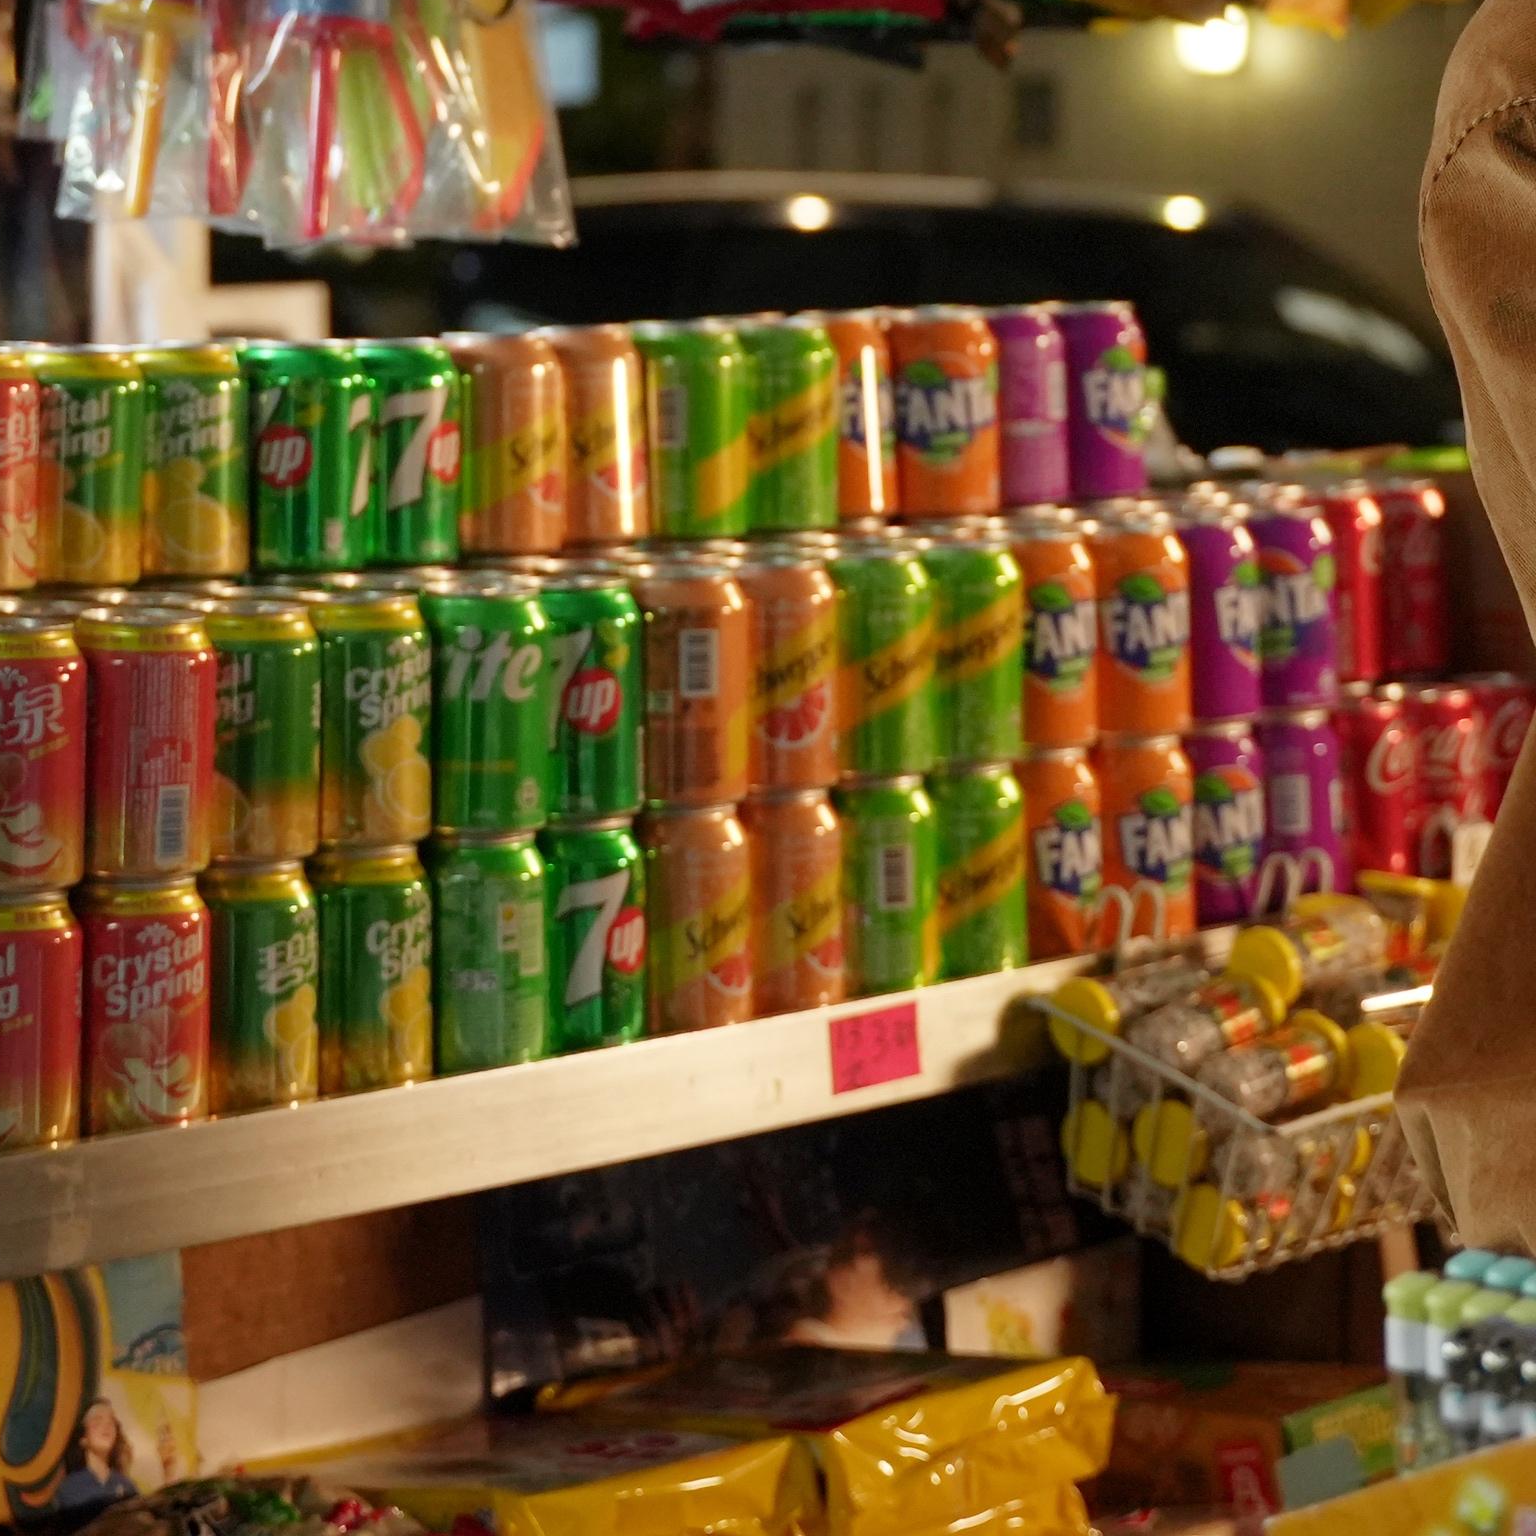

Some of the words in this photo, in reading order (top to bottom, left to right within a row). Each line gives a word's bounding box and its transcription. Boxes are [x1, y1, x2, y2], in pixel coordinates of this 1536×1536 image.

[444, 627, 542, 706] ite
[91, 922, 204, 989] Crystal
[104, 958, 205, 1022] Spring
